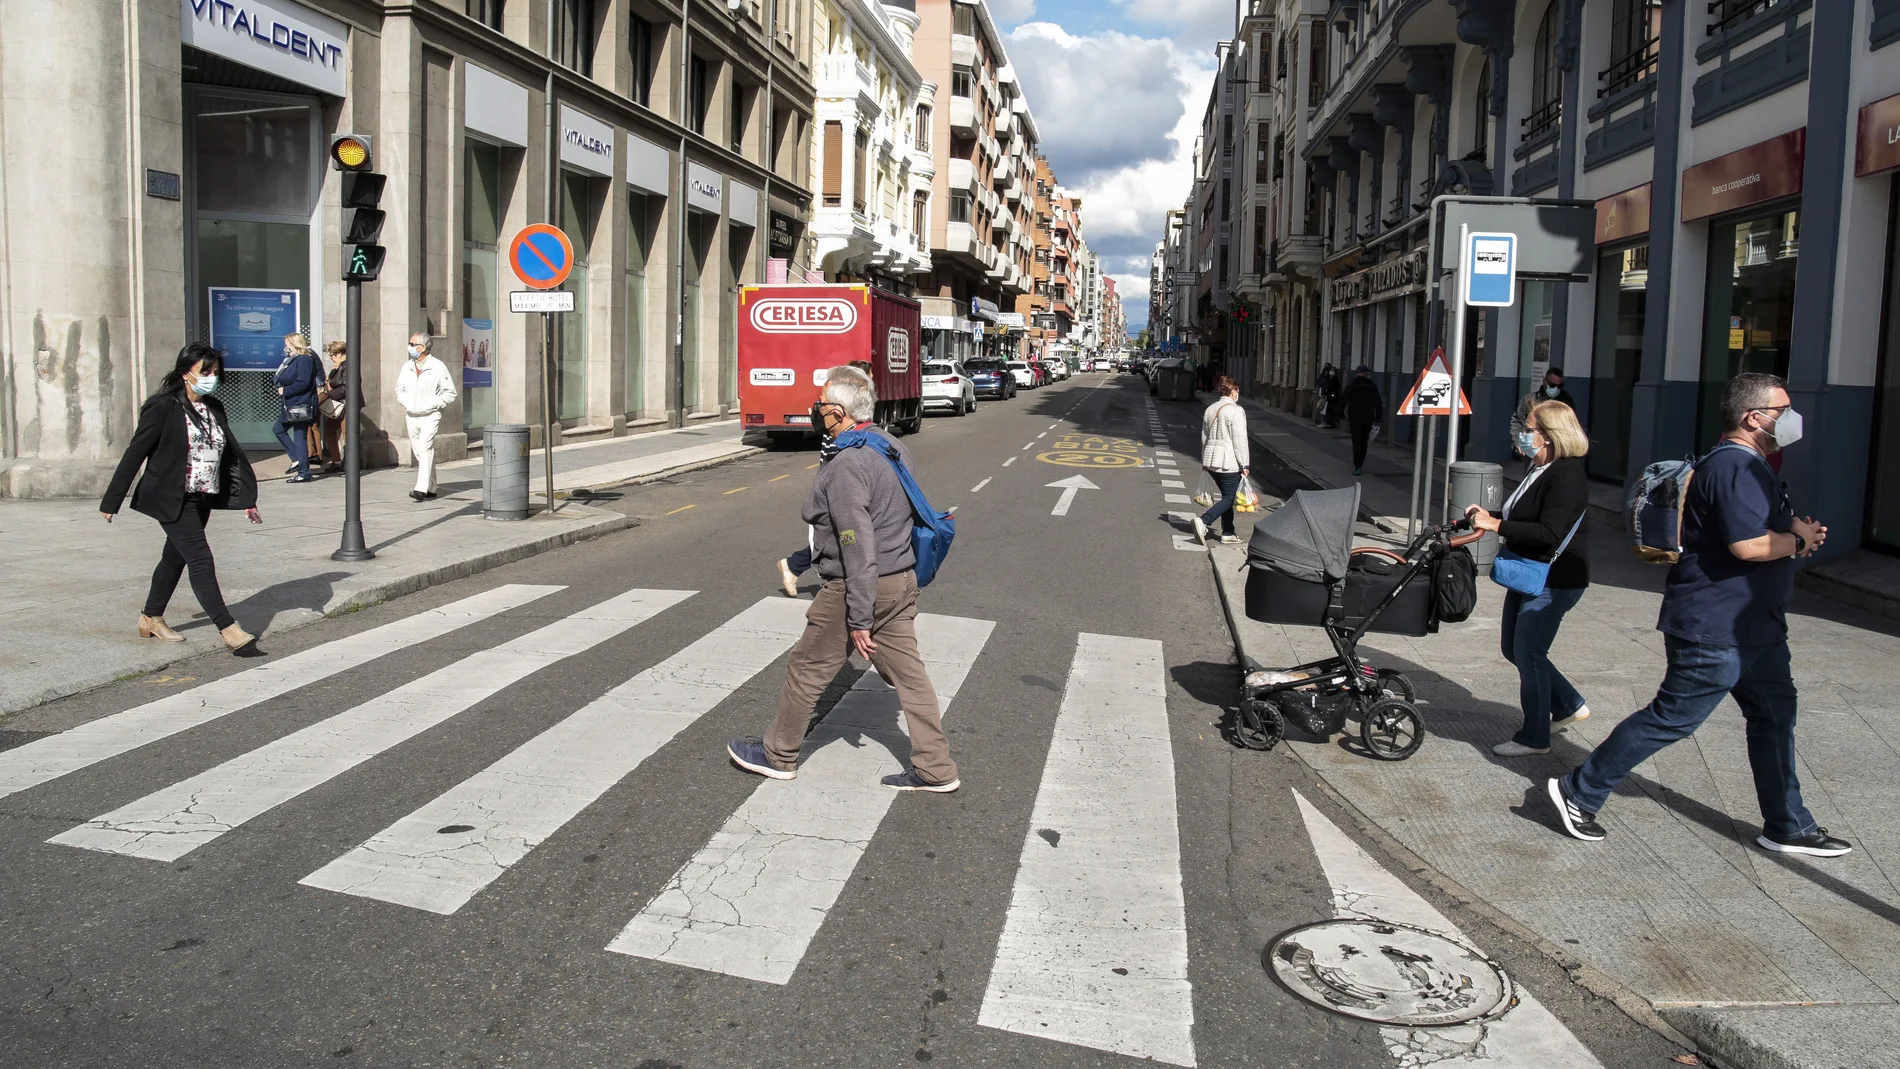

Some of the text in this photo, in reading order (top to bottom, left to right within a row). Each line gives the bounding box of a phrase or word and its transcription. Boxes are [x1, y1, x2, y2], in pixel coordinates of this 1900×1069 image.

[190, 0, 341, 67] VITALDENT
[564, 127, 612, 158] VITALDENT
[690, 178, 721, 200] VITALDENT
[1711, 172, 1761, 195] banca cooperativa
[759, 306, 845, 326] CERLESA
[1052, 441, 1138, 453] BUS
[1055, 453, 1126, 465] 20
